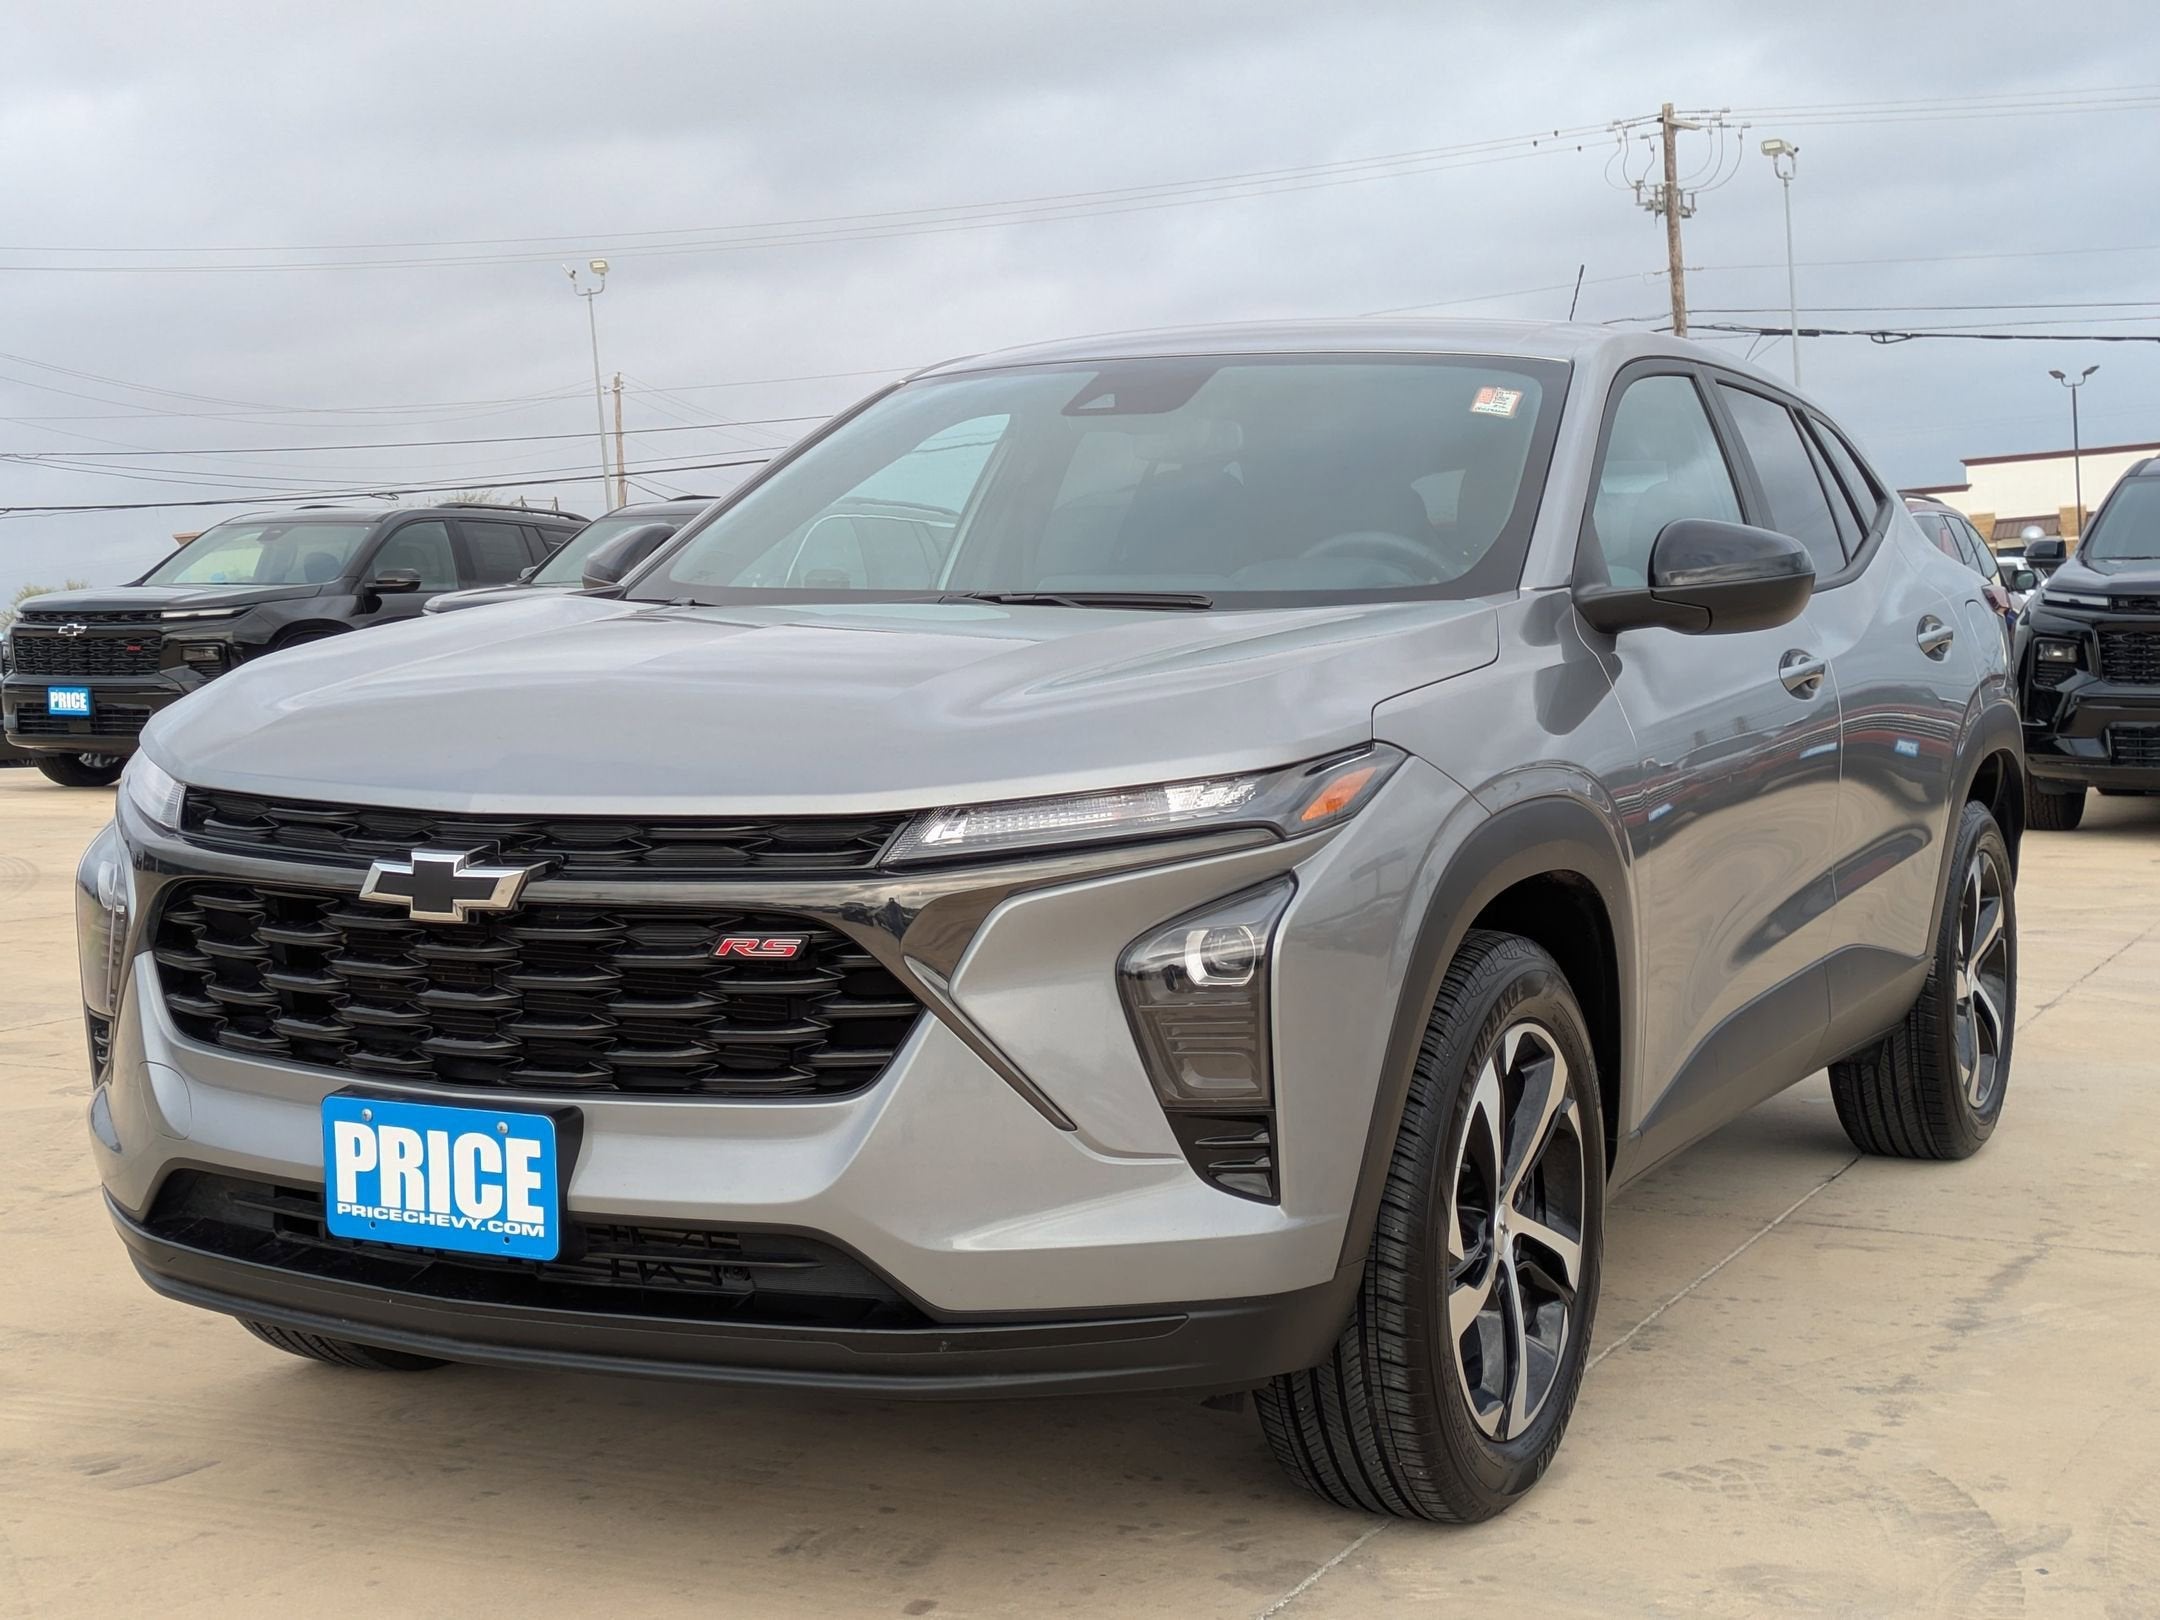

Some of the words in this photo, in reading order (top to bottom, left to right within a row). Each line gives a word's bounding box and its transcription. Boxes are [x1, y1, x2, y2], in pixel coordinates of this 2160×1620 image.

[50, 691, 87, 709] PRICE
[714, 938, 801, 957] RS
[334, 1120, 545, 1225] PRICE
[337, 1202, 545, 1238] PRICECHEVY.COM
